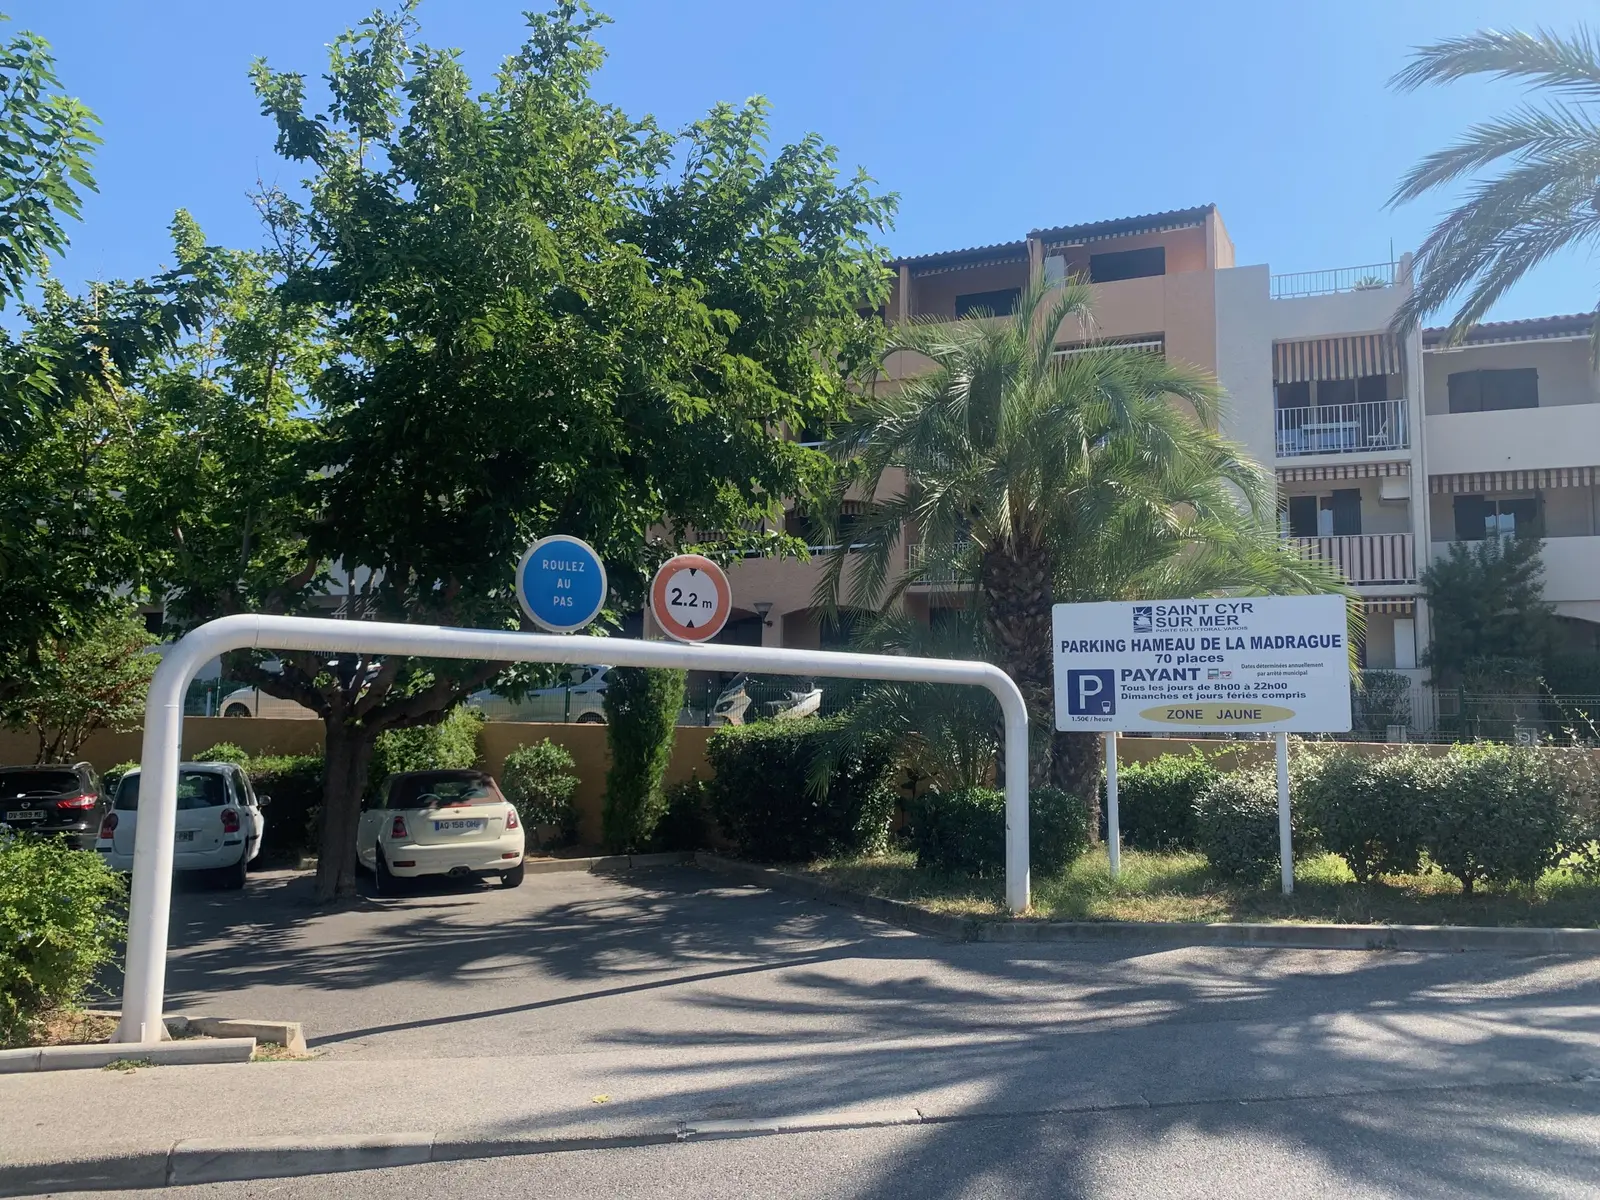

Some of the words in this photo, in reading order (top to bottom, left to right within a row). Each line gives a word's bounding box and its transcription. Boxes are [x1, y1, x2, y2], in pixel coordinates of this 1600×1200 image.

[542, 559, 585, 572] ROULEZ
[556, 578, 571, 589] AU
[553, 596, 573, 607] PAS
[671, 587, 698, 607] 2.2
[702, 599, 713, 609] m
[1155, 604, 1209, 616] SAINT
[1215, 602, 1254, 614] CYR
[1155, 616, 1193, 628] SUR
[1199, 615, 1240, 627] MER
[1061, 639, 1126, 653] PARKING
[1131, 637, 1195, 652] HAMEAU
[1201, 637, 1221, 650] DE
[1225, 636, 1246, 650] LA
[1250, 634, 1342, 649] MADRAGUE
[1155, 653, 1173, 664] 70
[1176, 653, 1225, 666] places
[1121, 667, 1201, 682] PAYANT
[1167, 683, 1194, 692] jours
[1197, 683, 1211, 691] de
[1214, 683, 1241, 691] 8h00
[1243, 682, 1251, 691] à
[1253, 682, 1288, 691] 22h00
[1121, 692, 1179, 700] Dimanches
[1196, 692, 1224, 700] jours
[1227, 691, 1258, 699] fériés
[1261, 691, 1307, 700] compris
[1167, 709, 1203, 720] ZONE
[1216, 709, 1262, 720] JAUNE
